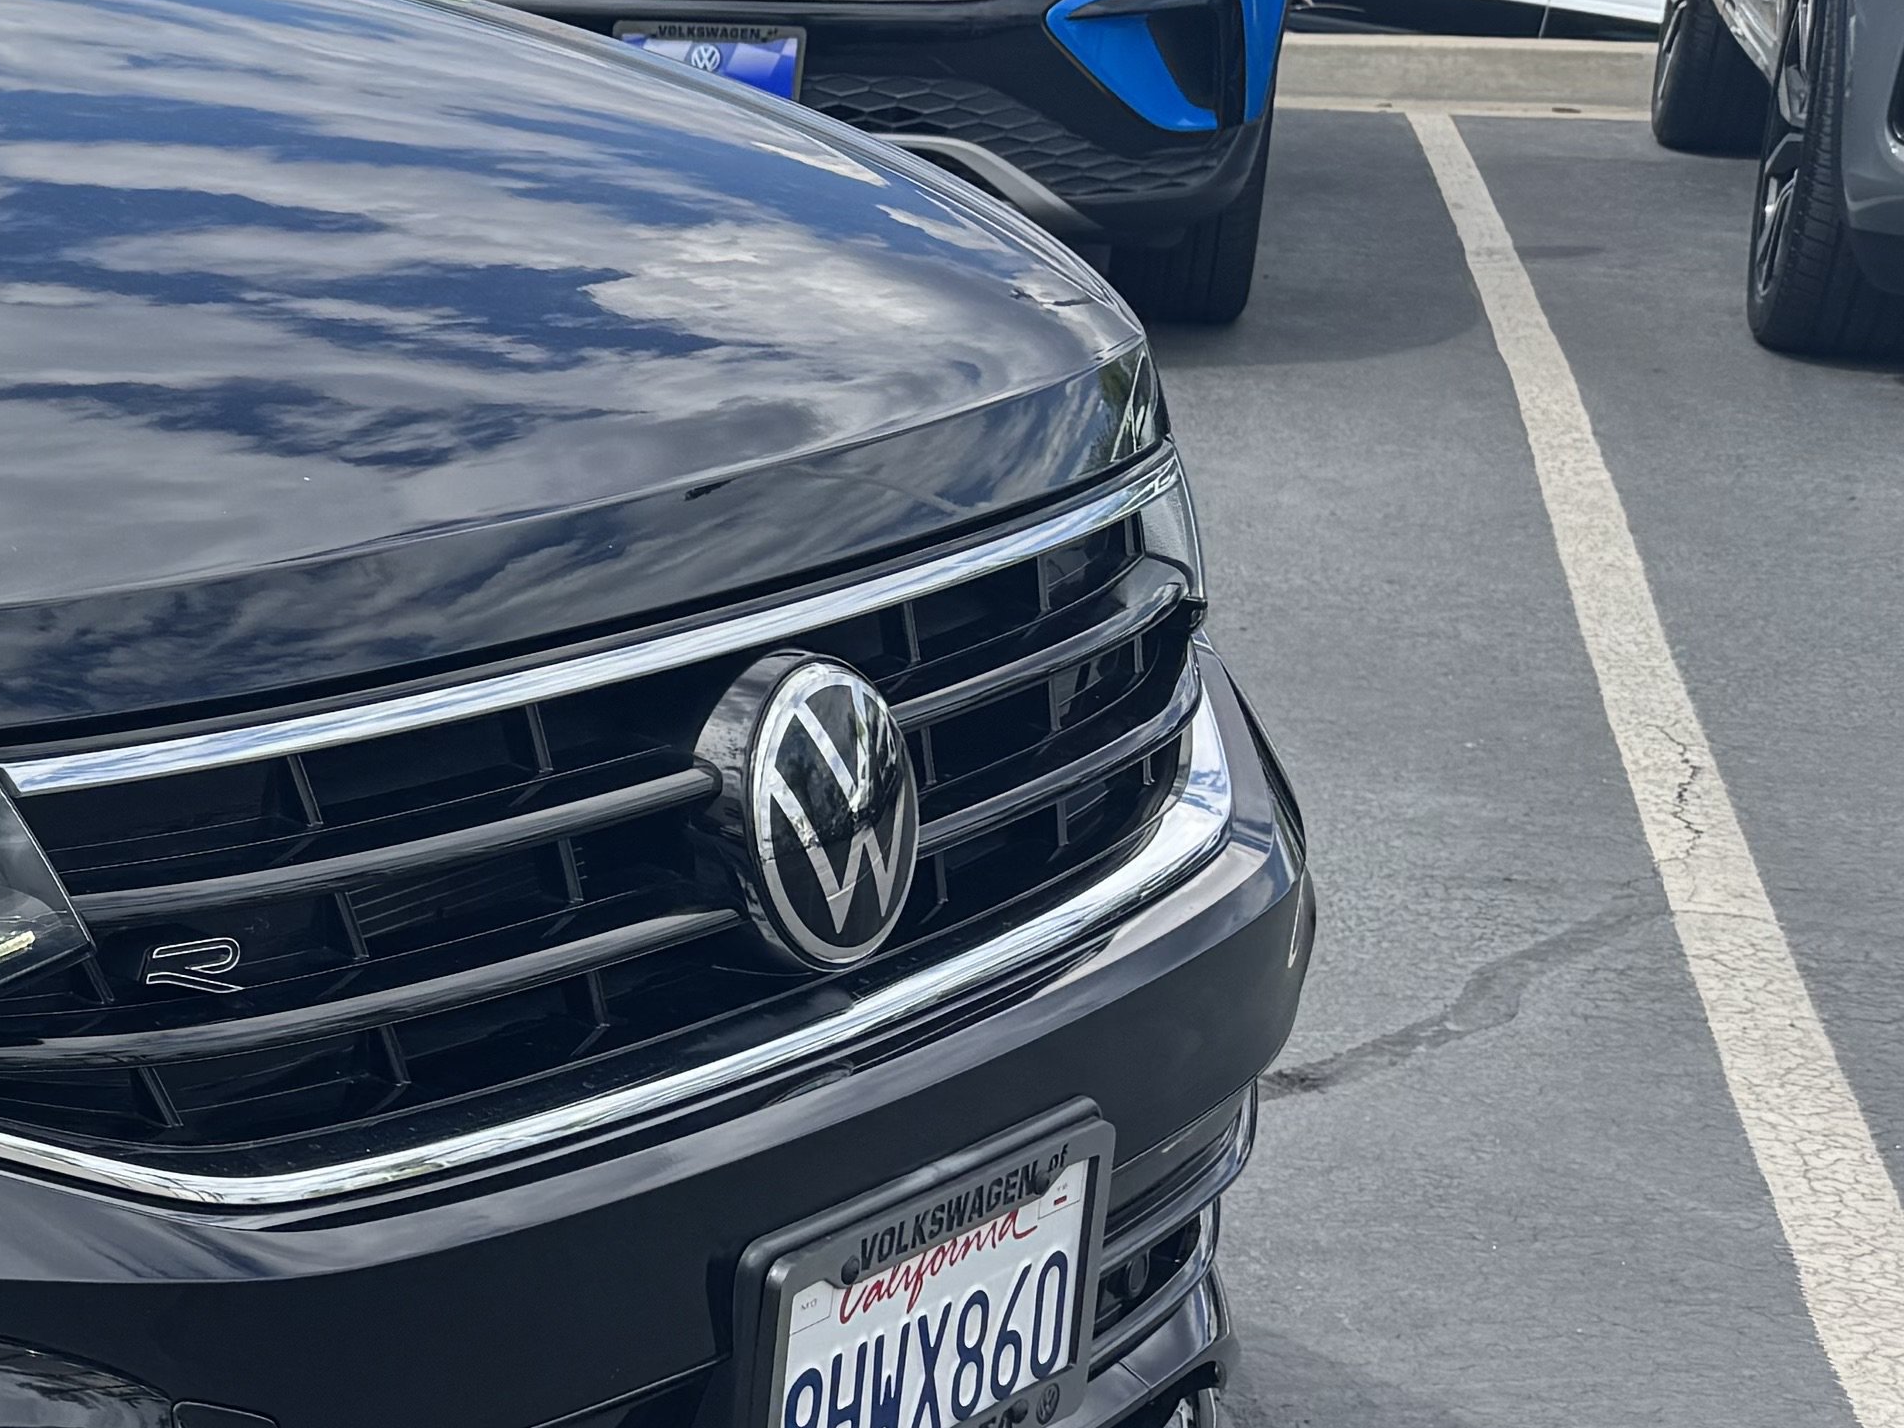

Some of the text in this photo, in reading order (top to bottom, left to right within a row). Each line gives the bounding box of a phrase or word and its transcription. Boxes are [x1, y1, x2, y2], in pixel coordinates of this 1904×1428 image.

[658, 24, 761, 41] VOLKSWAGEN
[691, 44, 721, 72] VW
[750, 660, 921, 968] VW
[146, 937, 243, 993] R
[859, 1144, 1069, 1271] VOLKSWAGEN of
[838, 1209, 1038, 1324] California
